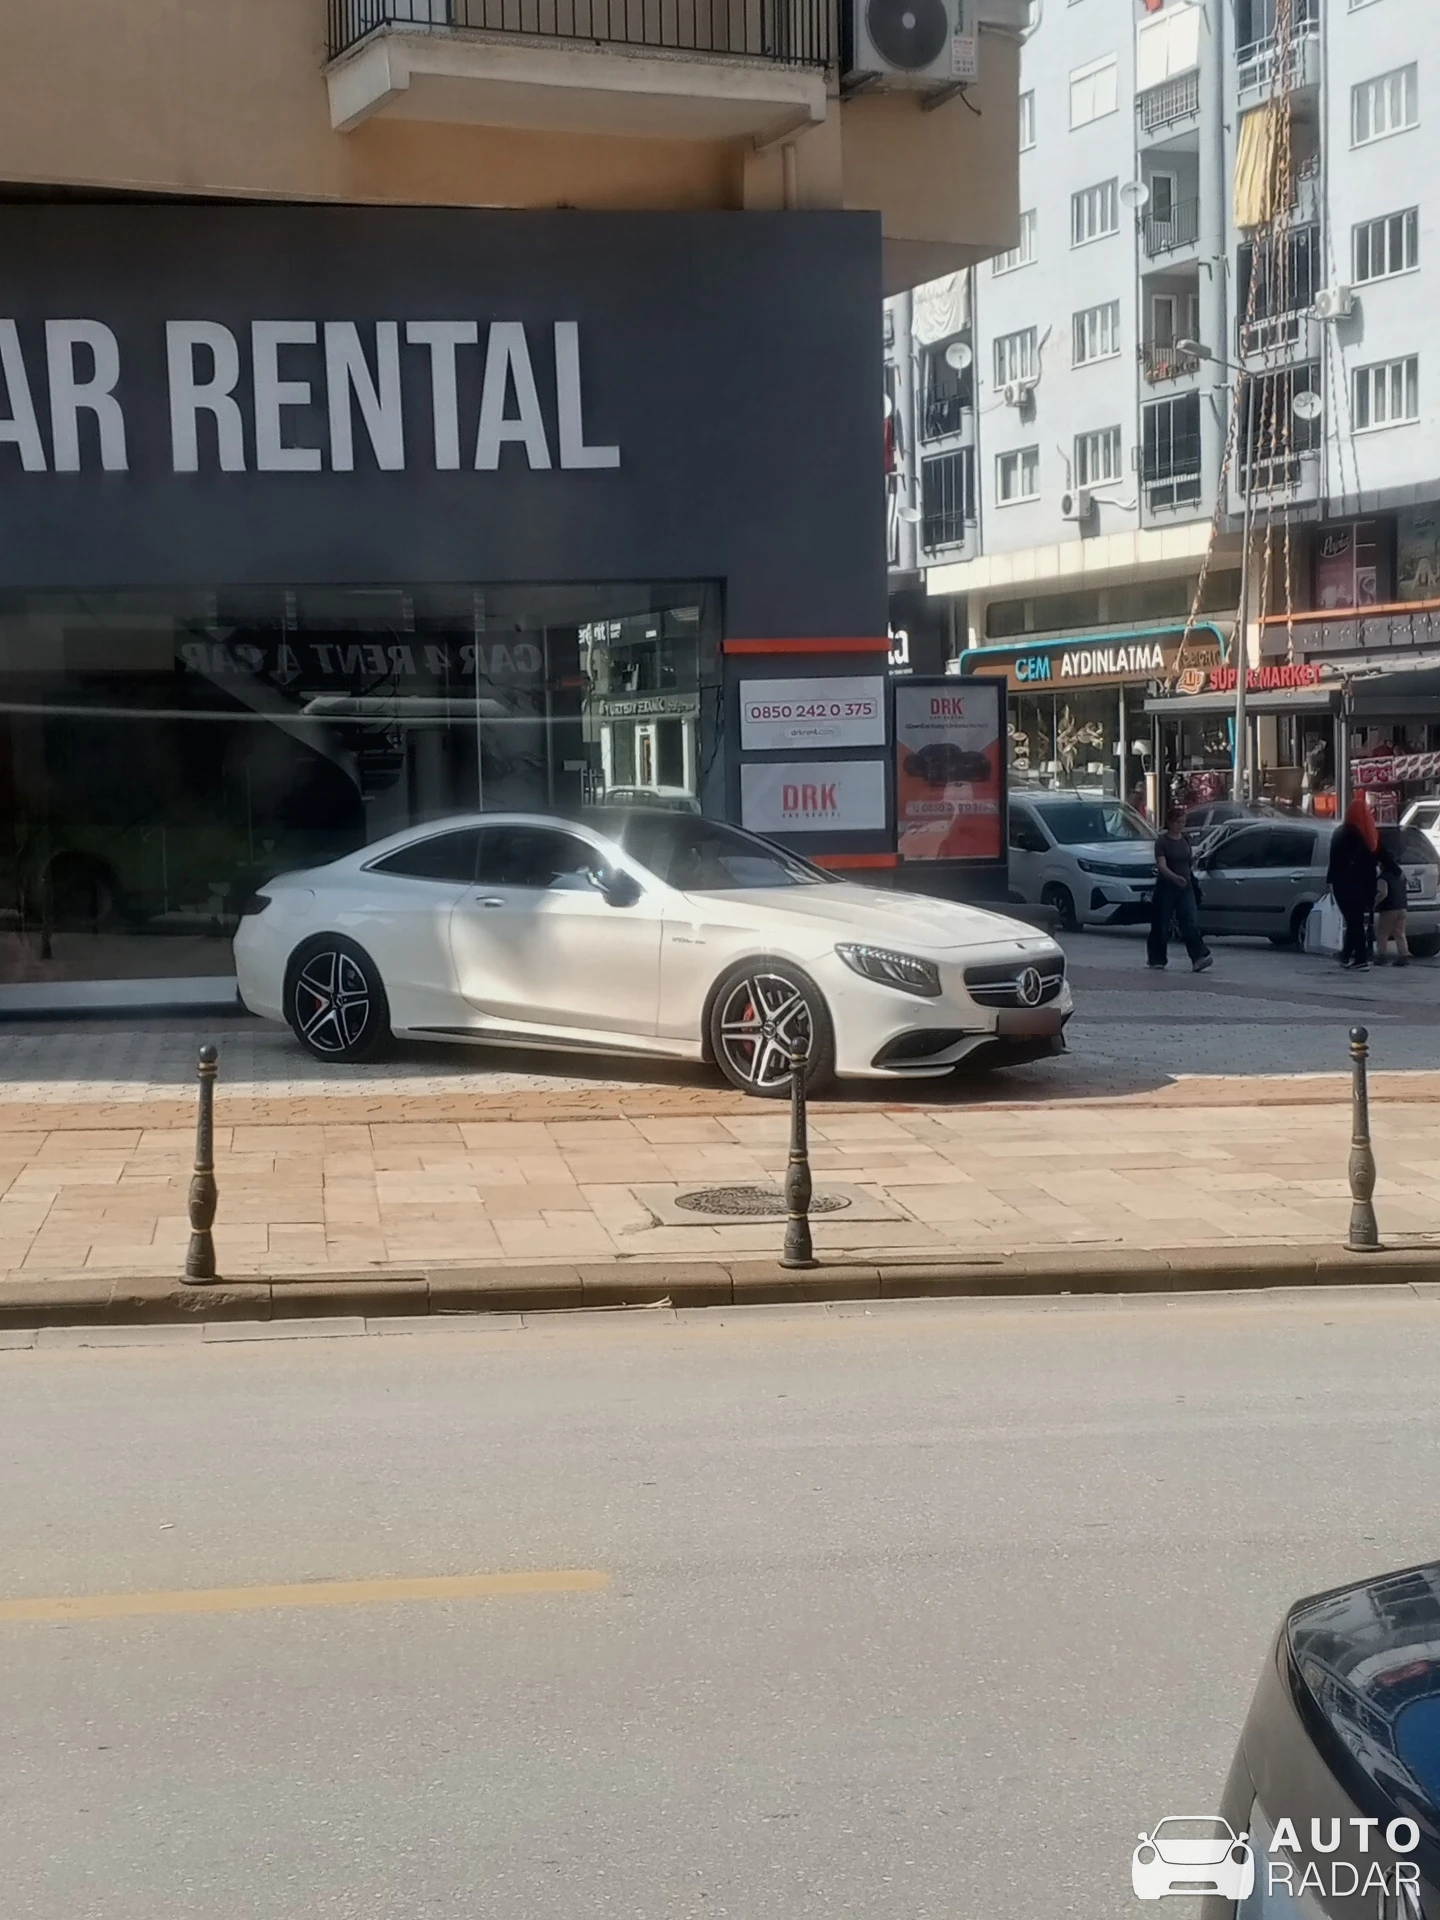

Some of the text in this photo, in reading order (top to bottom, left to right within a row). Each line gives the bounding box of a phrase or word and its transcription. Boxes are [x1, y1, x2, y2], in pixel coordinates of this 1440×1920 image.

[0, 319, 621, 472] AR RENTAL
[1015, 655, 1051, 682] CEM
[1060, 643, 1165, 677] AYDINLATMA
[1259, 664, 1321, 689] MARKET
[751, 703, 872, 719] 0850 242 0 375
[930, 697, 963, 715] DRK
[782, 783, 837, 811] DRK
